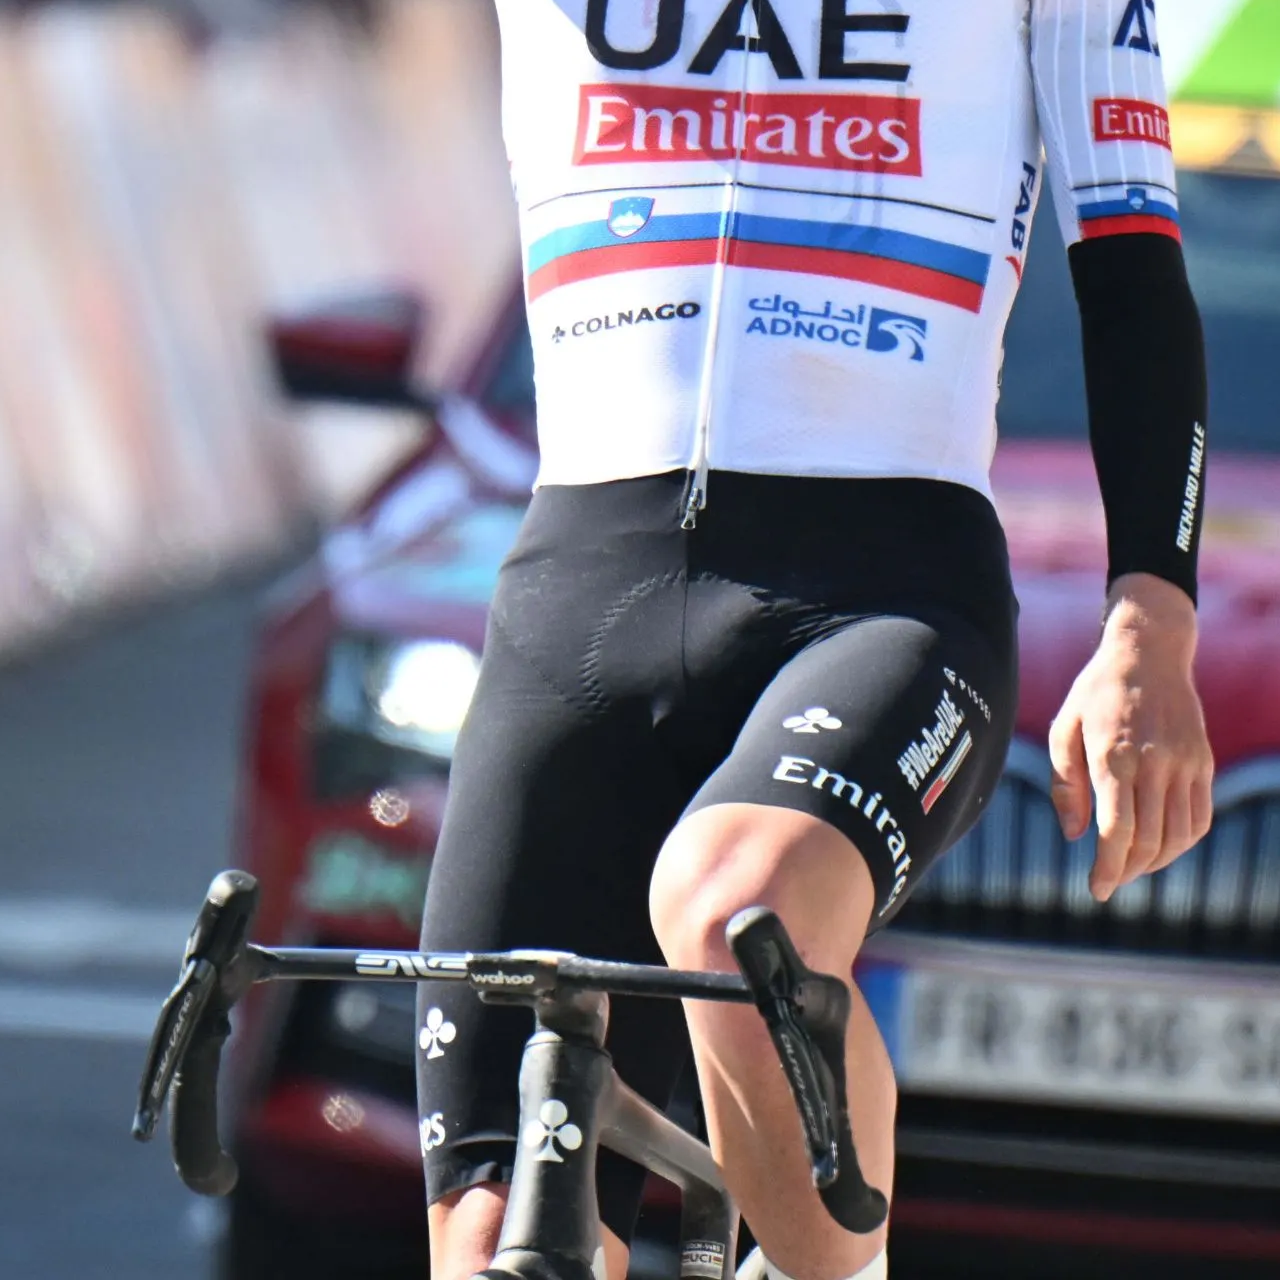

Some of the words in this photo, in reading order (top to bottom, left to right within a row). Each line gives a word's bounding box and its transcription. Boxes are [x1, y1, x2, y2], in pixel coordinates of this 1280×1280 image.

[585, 95, 909, 163] Emirates
[571, 302, 701, 337] COLNAGO
[745, 317, 862, 348] ADNOC
[1176, 473, 1200, 553] RICHARD
[1188, 421, 1205, 478] MILLE
[471, 972, 535, 985] wahoo
